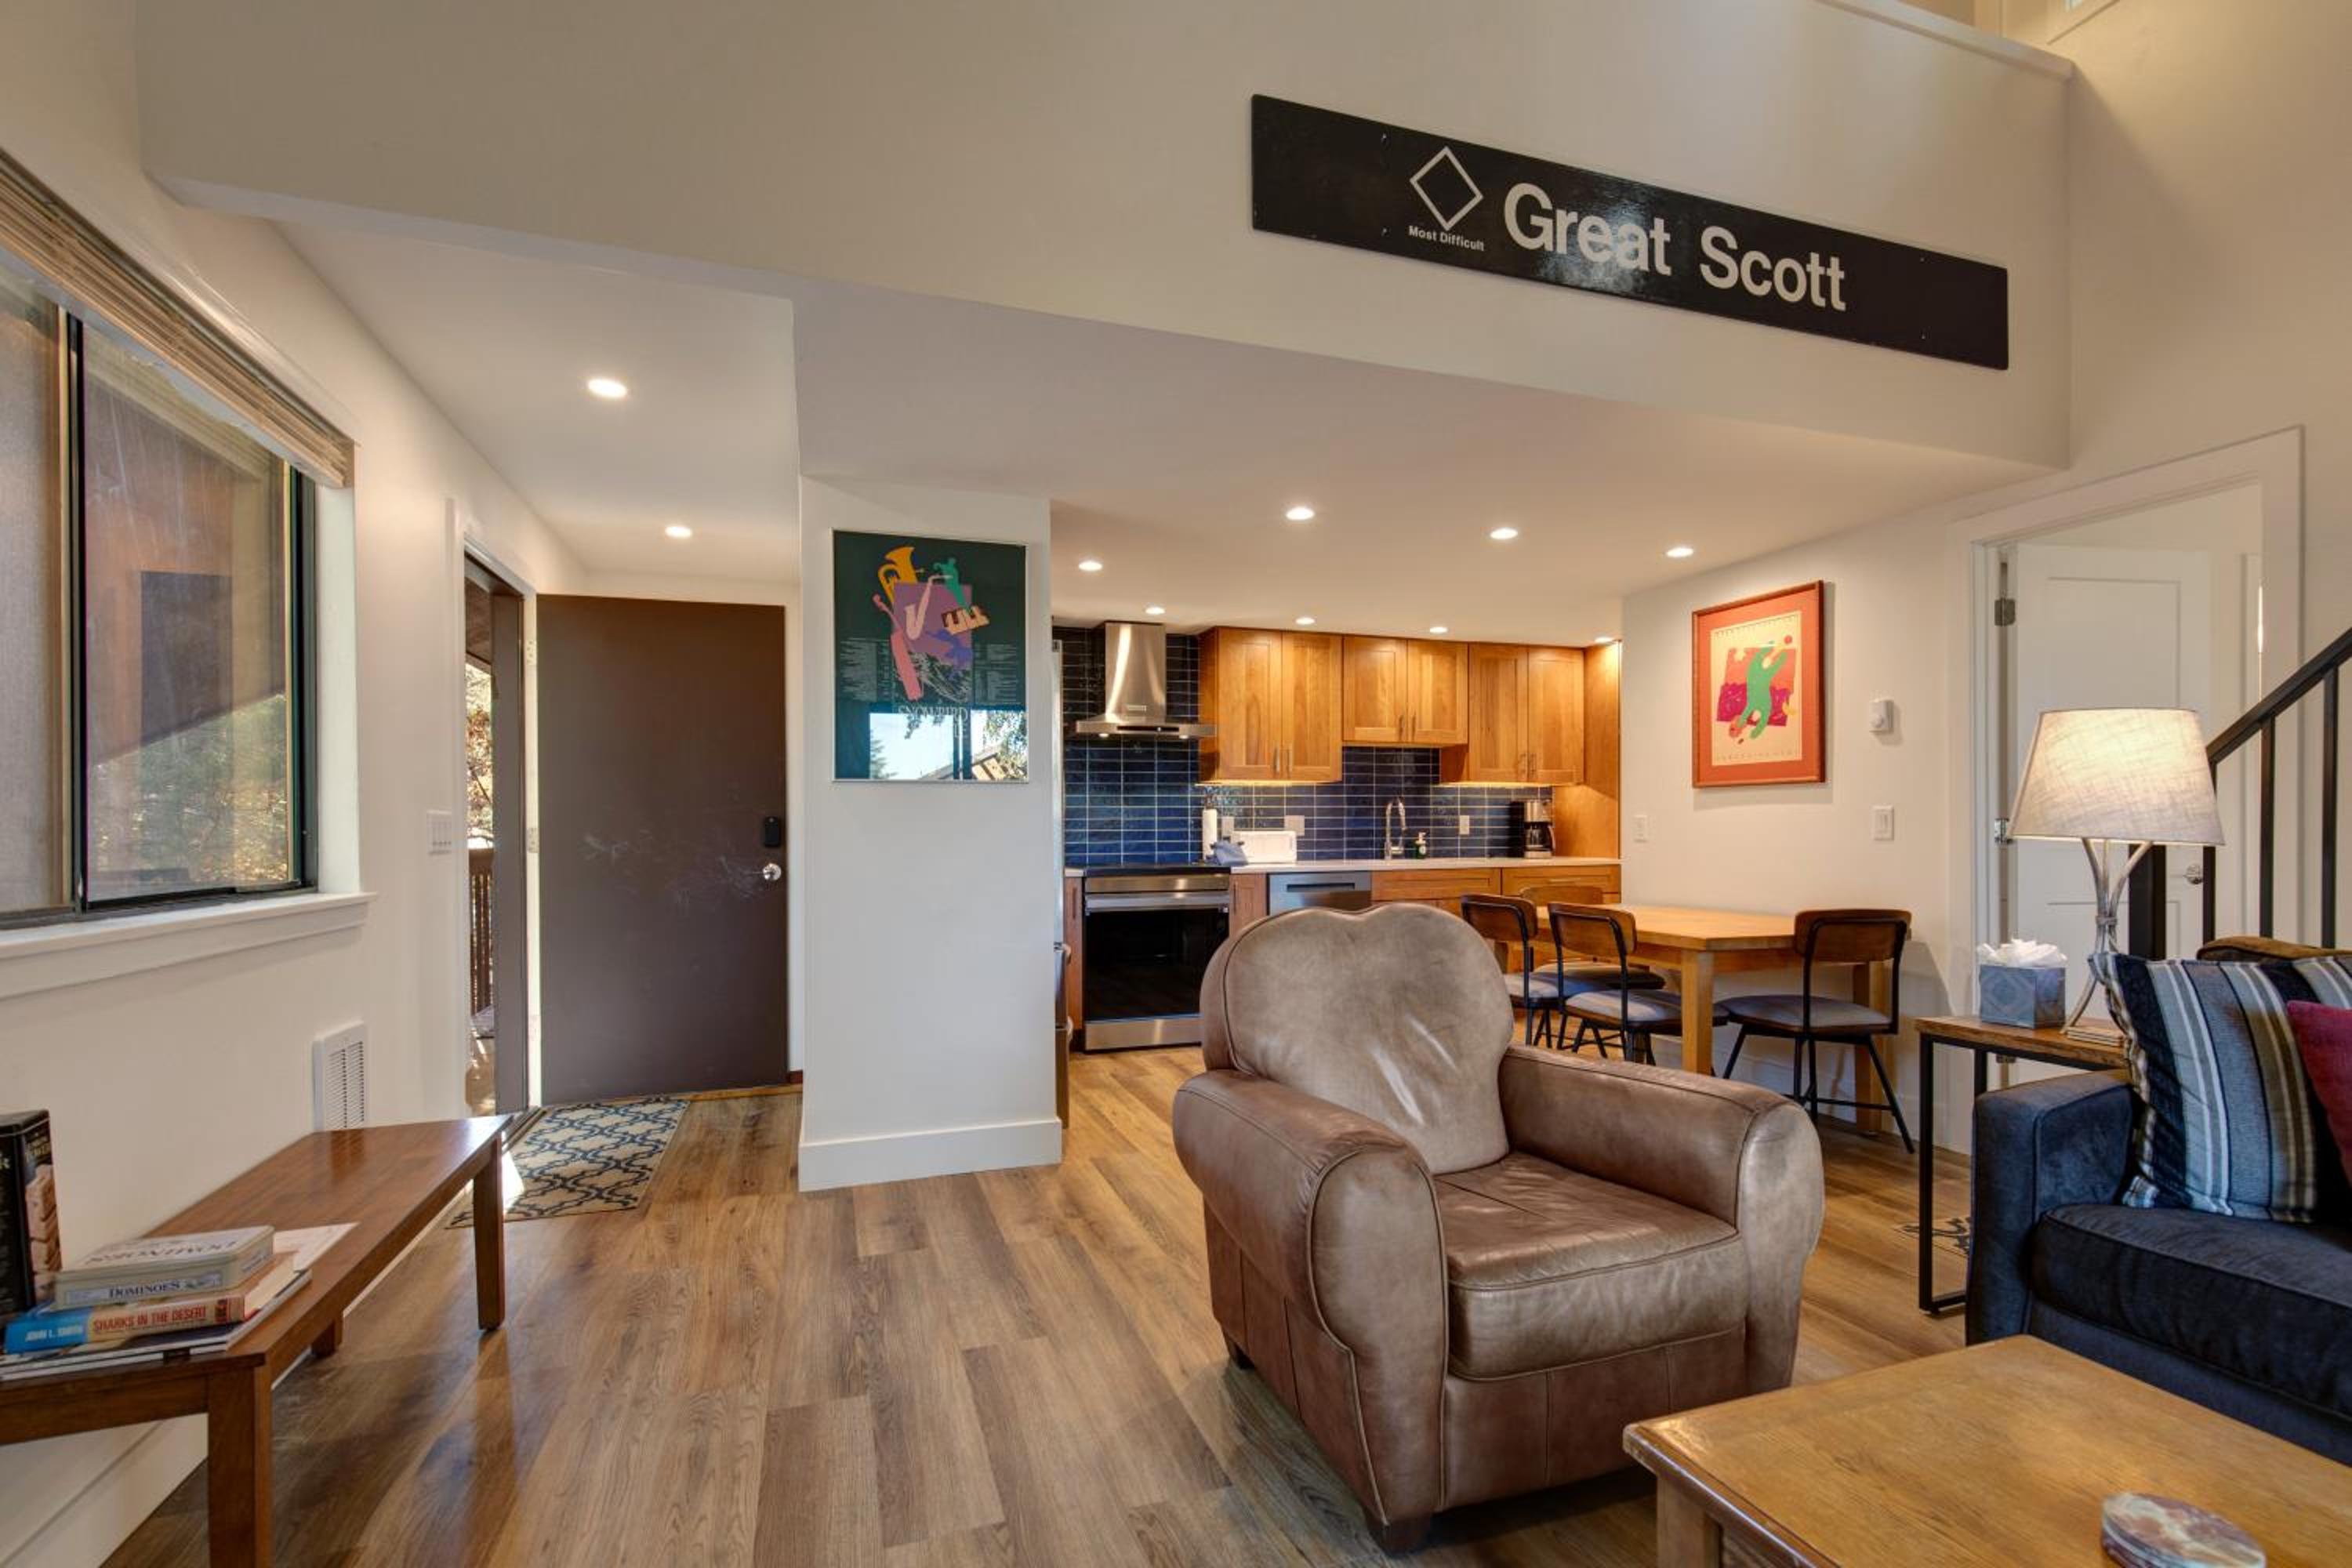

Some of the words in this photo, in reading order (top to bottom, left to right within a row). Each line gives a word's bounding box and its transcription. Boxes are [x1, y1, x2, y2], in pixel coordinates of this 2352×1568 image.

[1409, 225, 1437, 241] Most
[1439, 232, 1484, 251] Difficult
[1504, 183, 1671, 276] Great
[1699, 225, 1846, 311] Scott
[108, 1280, 180, 1298] DOMINOES
[93, 1316, 134, 1331] SHARKS
[138, 1312, 147, 1325] IN
[151, 1309, 169, 1323] THE
[172, 1305, 206, 1321] DESERT
